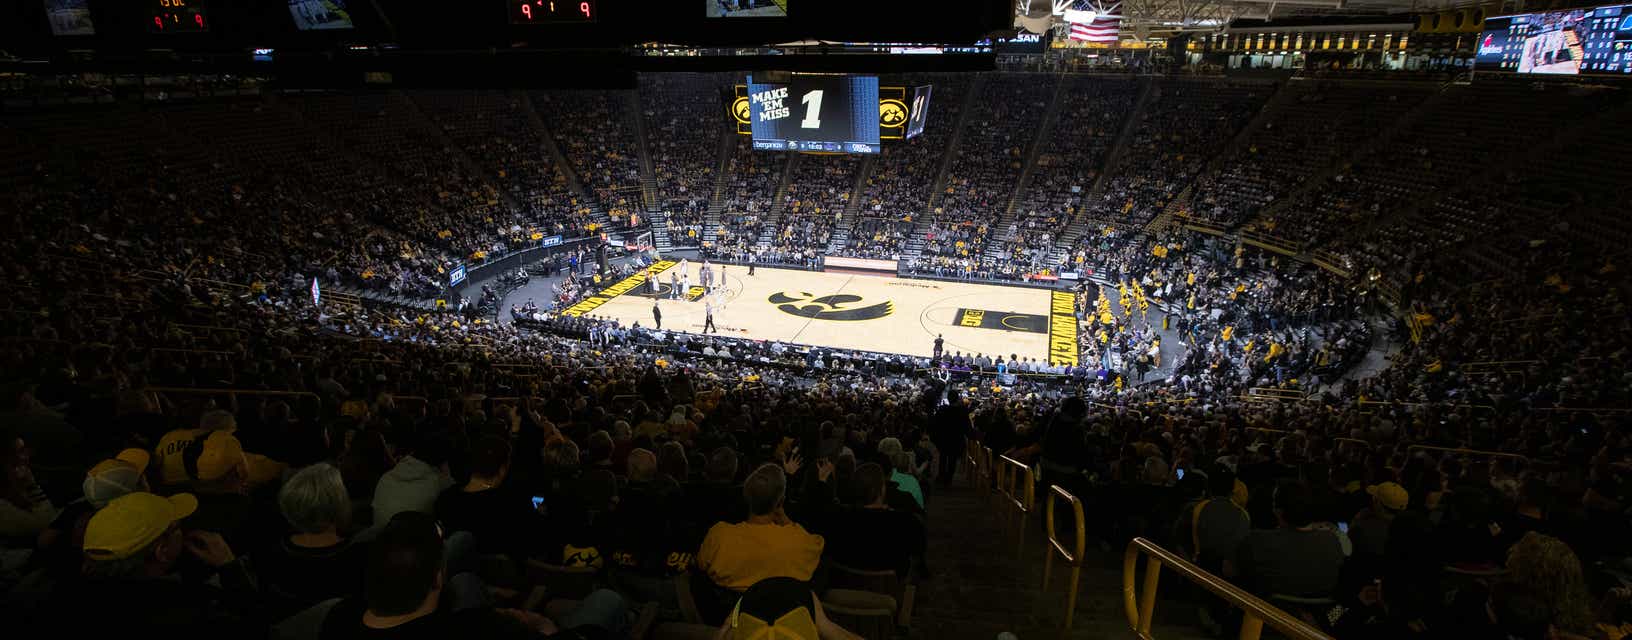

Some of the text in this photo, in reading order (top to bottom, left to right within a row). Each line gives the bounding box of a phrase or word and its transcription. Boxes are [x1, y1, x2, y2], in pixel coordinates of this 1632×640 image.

[522, 4, 531, 19] 9
[580, 2, 590, 18] 9
[154, 16, 163, 30] 9
[195, 14, 203, 28] 9
[752, 88, 788, 104] MAKE
[759, 107, 790, 122] MISS
[801, 90, 824, 129] 1
[544, 237, 560, 246] BTN
[451, 269, 463, 283] BTN
